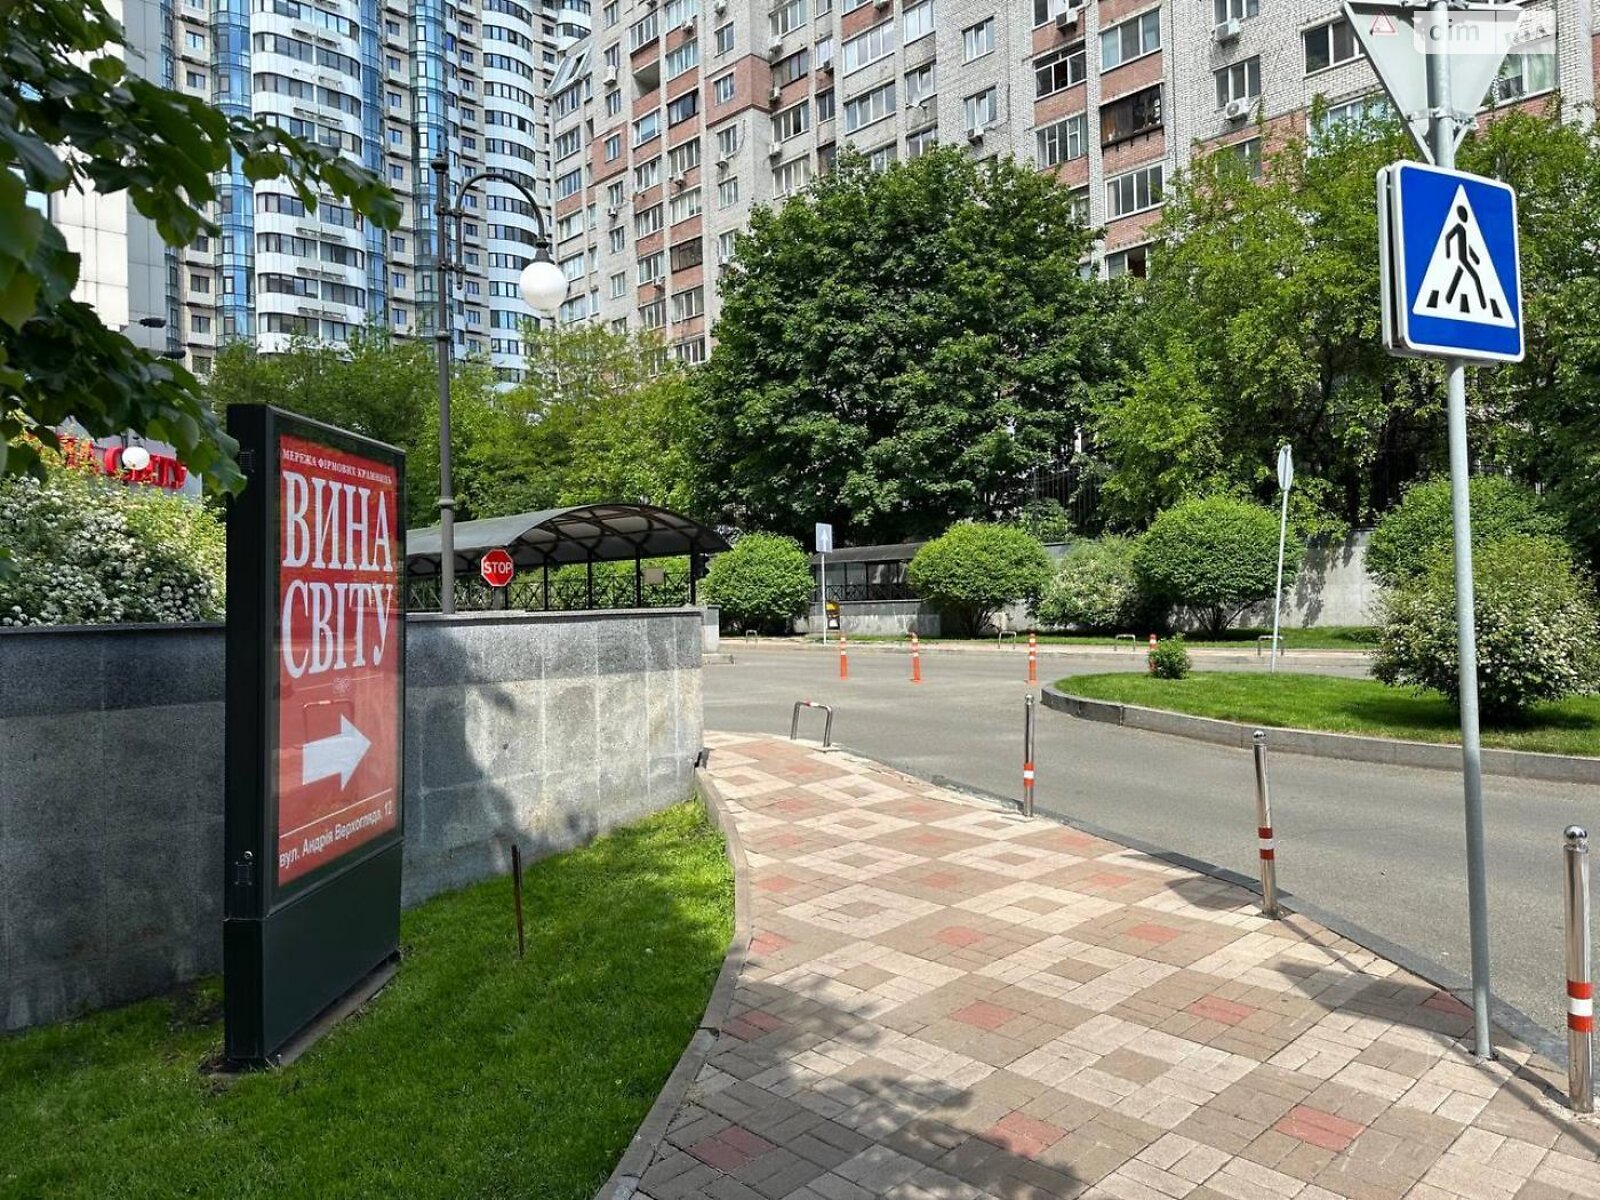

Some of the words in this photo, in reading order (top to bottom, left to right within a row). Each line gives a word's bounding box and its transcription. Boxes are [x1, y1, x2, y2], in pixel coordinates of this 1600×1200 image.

[282, 448, 317, 467] МЕРЕЖА
[282, 471, 394, 572] ВИНА
[484, 561, 512, 574] STOP
[282, 579, 394, 679] СВІТУ
[279, 847, 300, 869] вул.
[302, 829, 334, 858] Андрія
